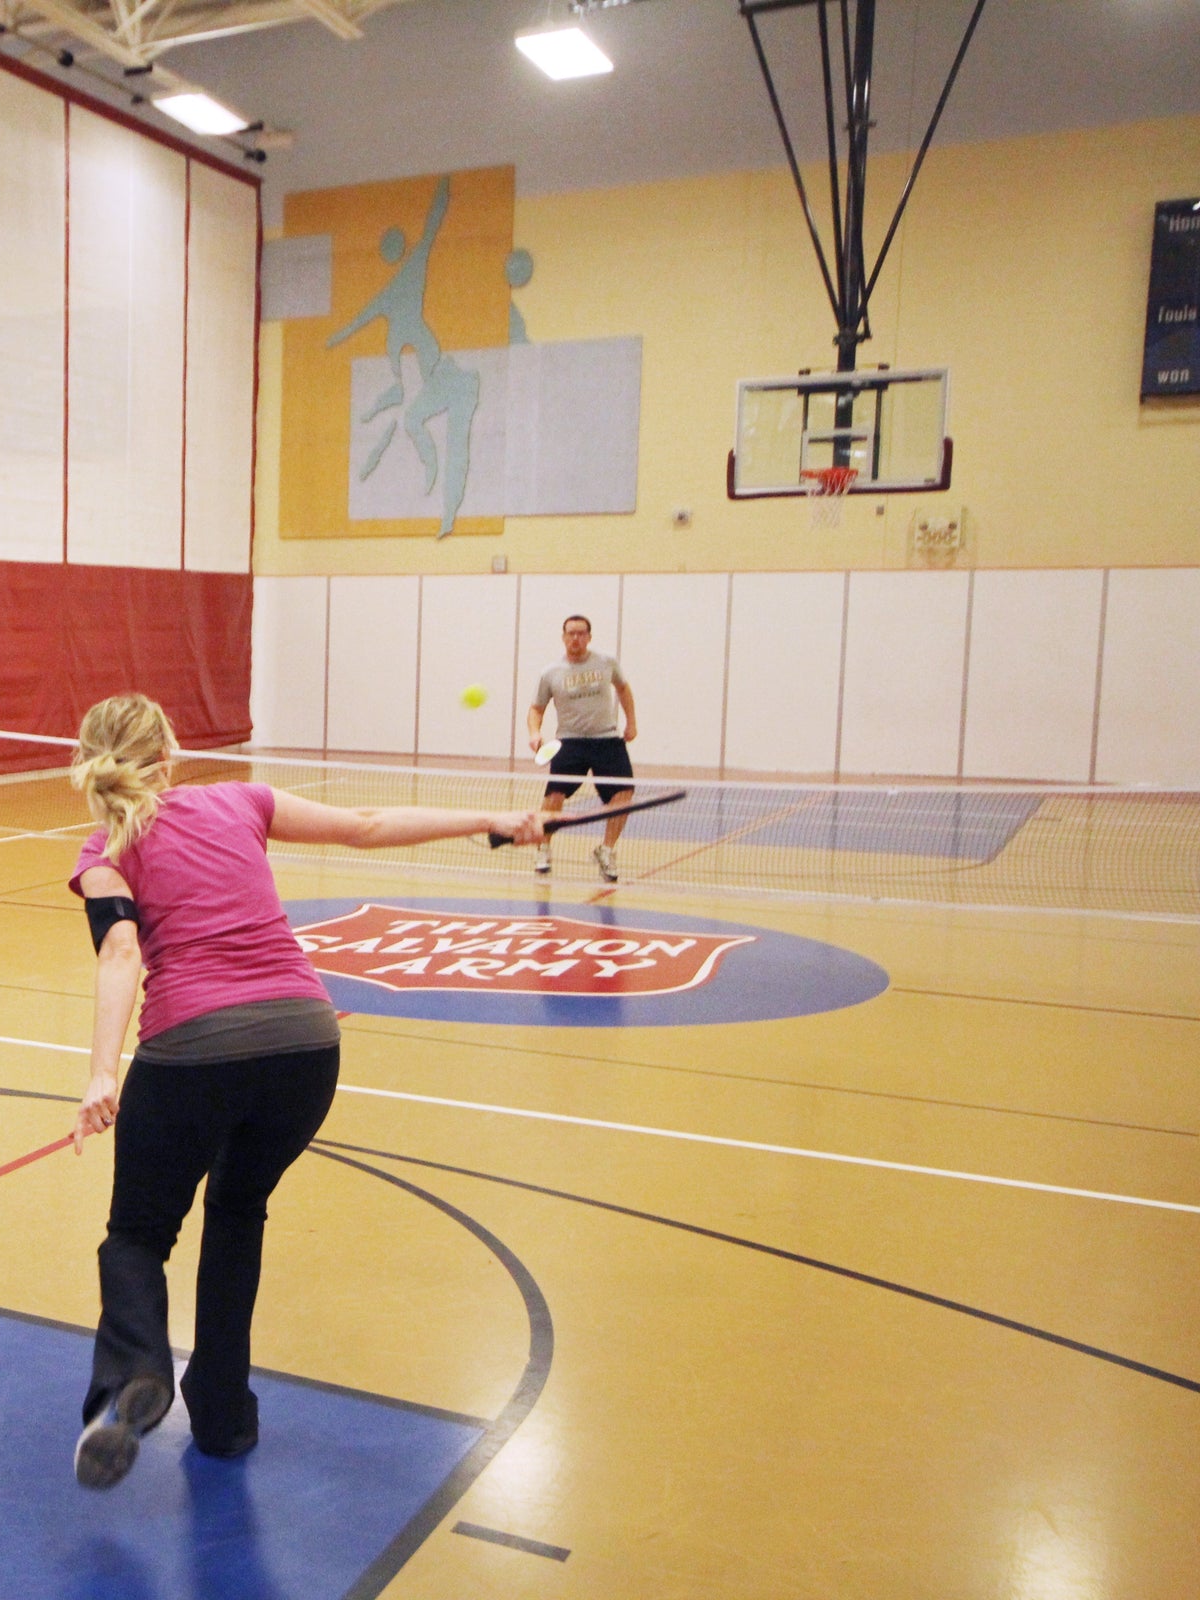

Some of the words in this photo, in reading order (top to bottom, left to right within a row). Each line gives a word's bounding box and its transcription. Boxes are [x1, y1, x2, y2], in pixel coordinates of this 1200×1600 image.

[384, 919, 558, 936] THE
[294, 934, 697, 957] SALVATION
[363, 956, 658, 980] ARMY
